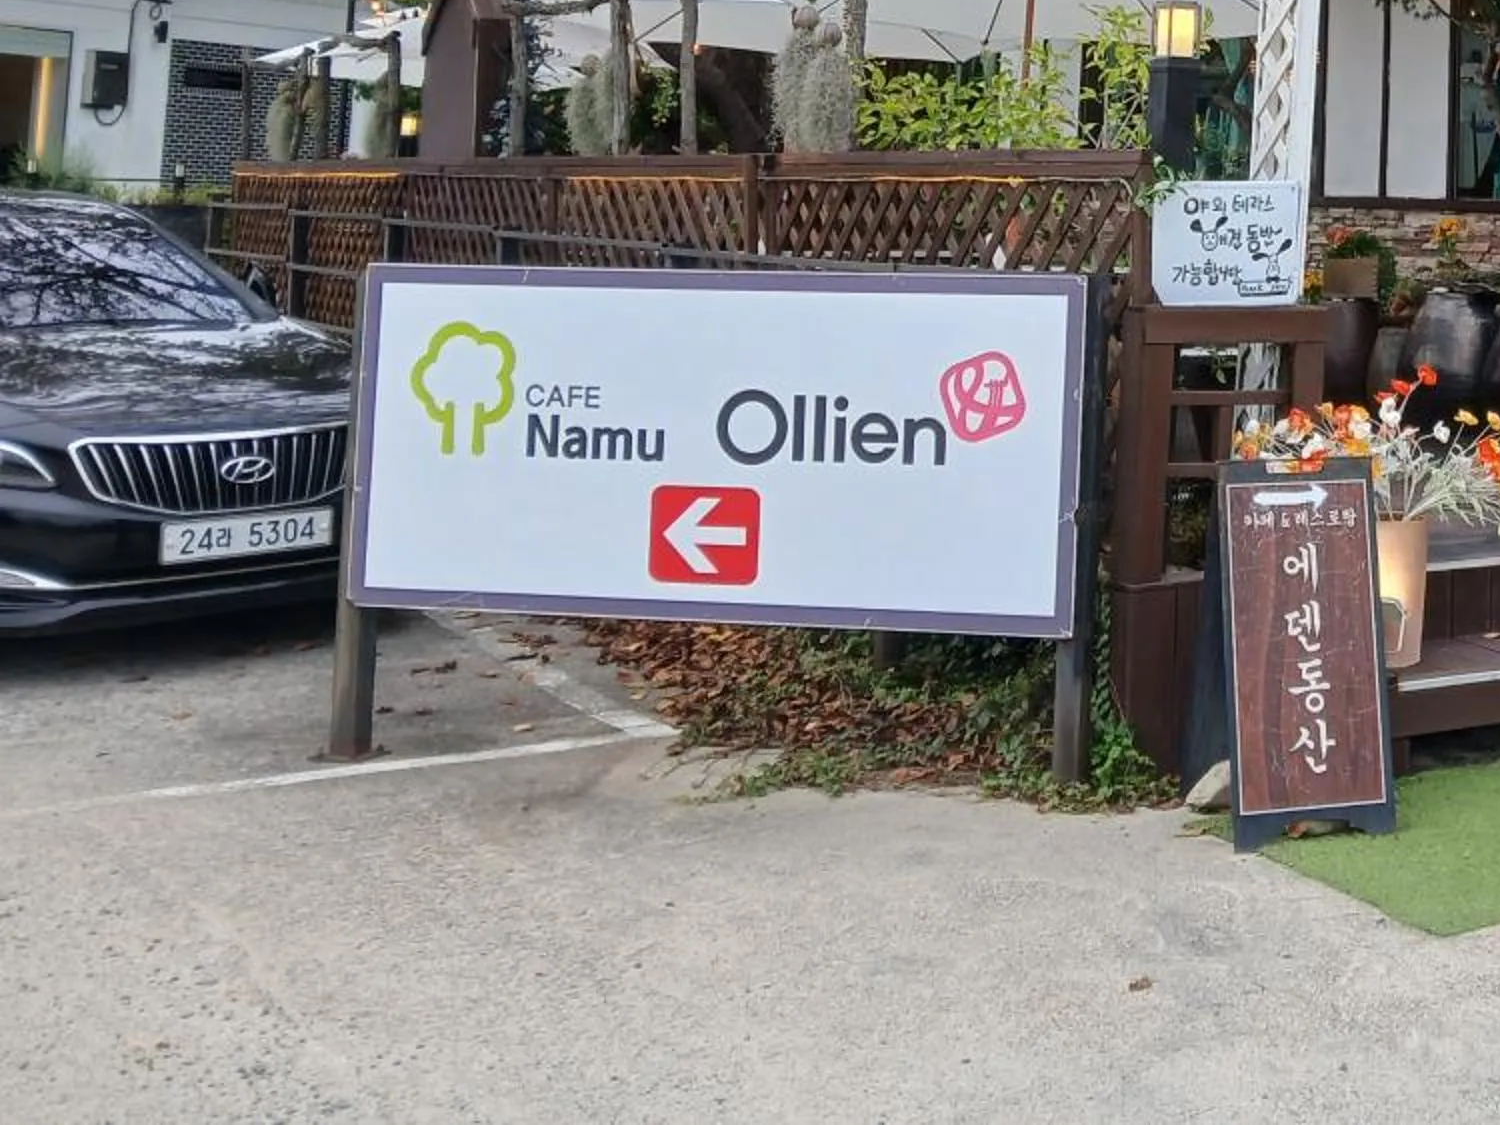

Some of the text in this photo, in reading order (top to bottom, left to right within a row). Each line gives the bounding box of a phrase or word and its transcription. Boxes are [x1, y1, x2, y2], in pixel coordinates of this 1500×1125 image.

[1184, 194, 1275, 215] 야외 테라스
[1246, 224, 1282, 253] 동반
[1172, 259, 1243, 286] 가능합니다
[525, 384, 601, 409] CAFE
[525, 414, 666, 463] Namu
[717, 388, 948, 467] Ollien
[179, 517, 316, 556] 24라 5304
[1283, 542, 1336, 774] 에덴동산
